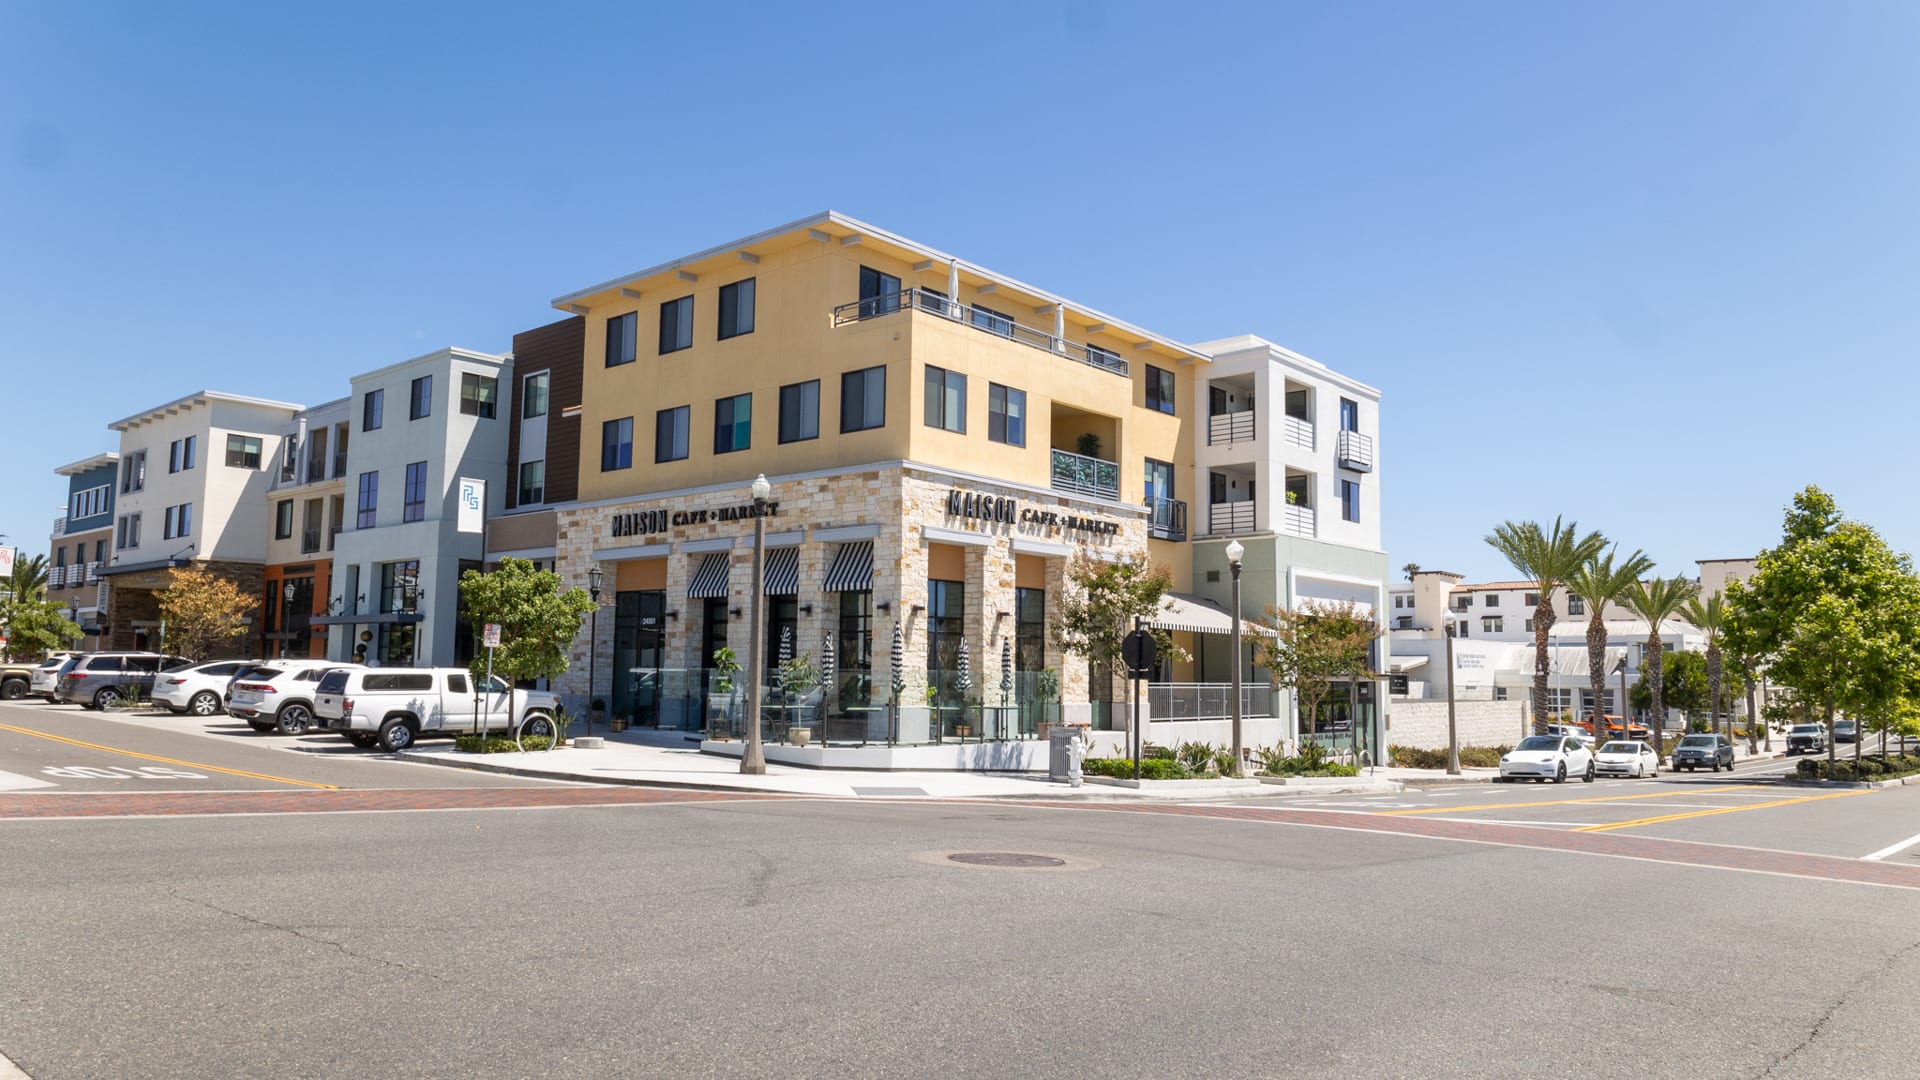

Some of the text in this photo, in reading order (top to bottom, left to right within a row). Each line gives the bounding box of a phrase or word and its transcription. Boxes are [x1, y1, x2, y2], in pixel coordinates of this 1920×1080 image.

[612, 509, 668, 537] MAISON
[672, 509, 707, 527] CAFE
[949, 489, 1017, 524] MAISON
[1022, 508, 1059, 526] CAFE
[1068, 515, 1120, 535] MARKET
[41, 766, 209, 779] STOP
